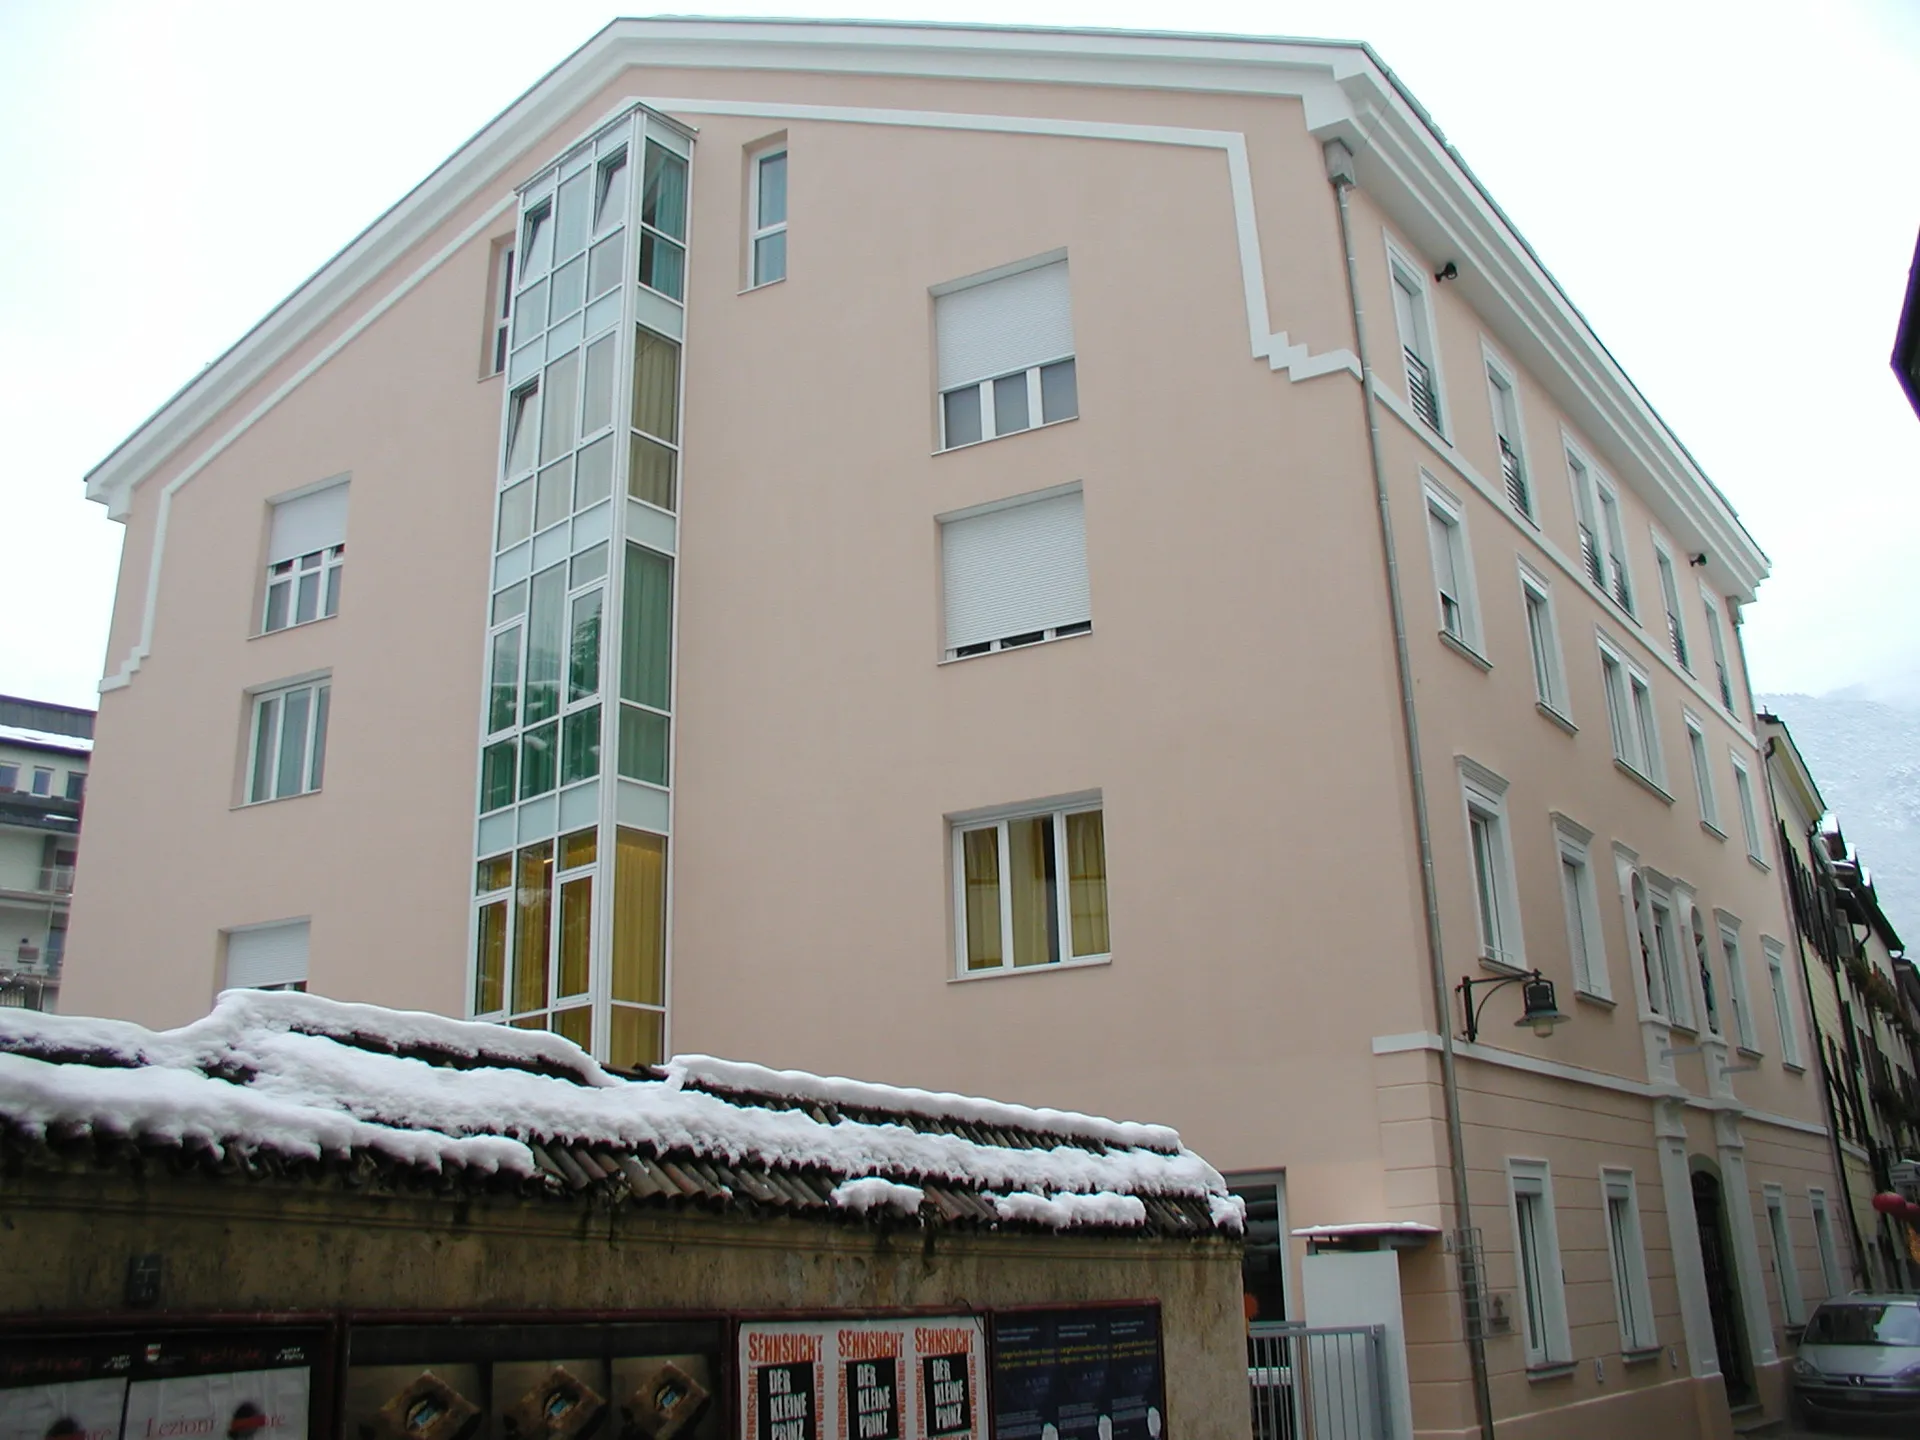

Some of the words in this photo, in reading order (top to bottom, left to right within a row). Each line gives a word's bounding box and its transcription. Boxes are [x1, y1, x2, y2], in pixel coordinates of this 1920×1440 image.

[748, 1332, 823, 1362] SEHNSUCHT
[838, 1329, 905, 1358] SEHNSUCHT
[915, 1327, 974, 1354] SEHNSUCHT
[768, 1368, 792, 1395] DER
[857, 1364, 877, 1388] DER
[933, 1359, 952, 1381] DER
[858, 1385, 891, 1414] KLEINE
[934, 1380, 964, 1406] KLEINE
[770, 1392, 807, 1422] KLEINE
[936, 1403, 962, 1429] PRINZ
[146, 1414, 215, 1437] Lezioni
[859, 1410, 888, 1438] PRINZ
